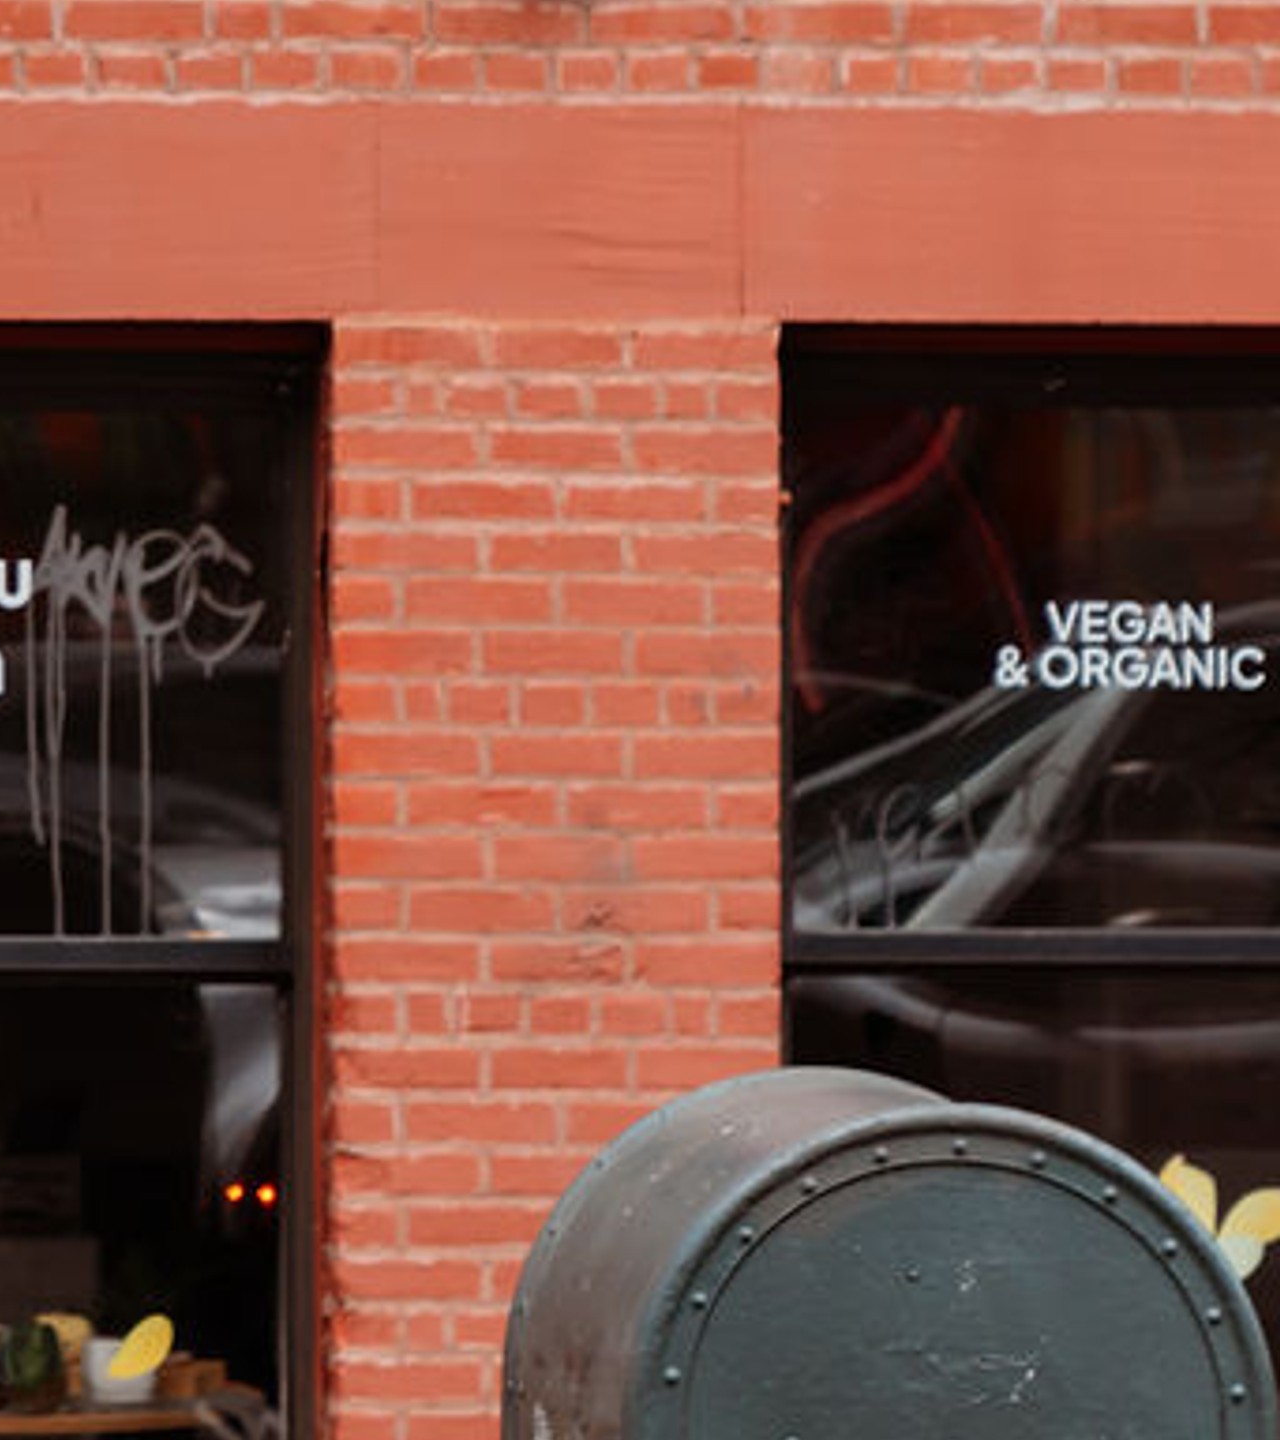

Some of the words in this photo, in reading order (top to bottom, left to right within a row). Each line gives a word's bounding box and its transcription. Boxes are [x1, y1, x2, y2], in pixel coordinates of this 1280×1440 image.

[1046, 601, 1214, 644] VEGAN
[994, 645, 1030, 689] &
[1039, 647, 1267, 689] ORGANIC
